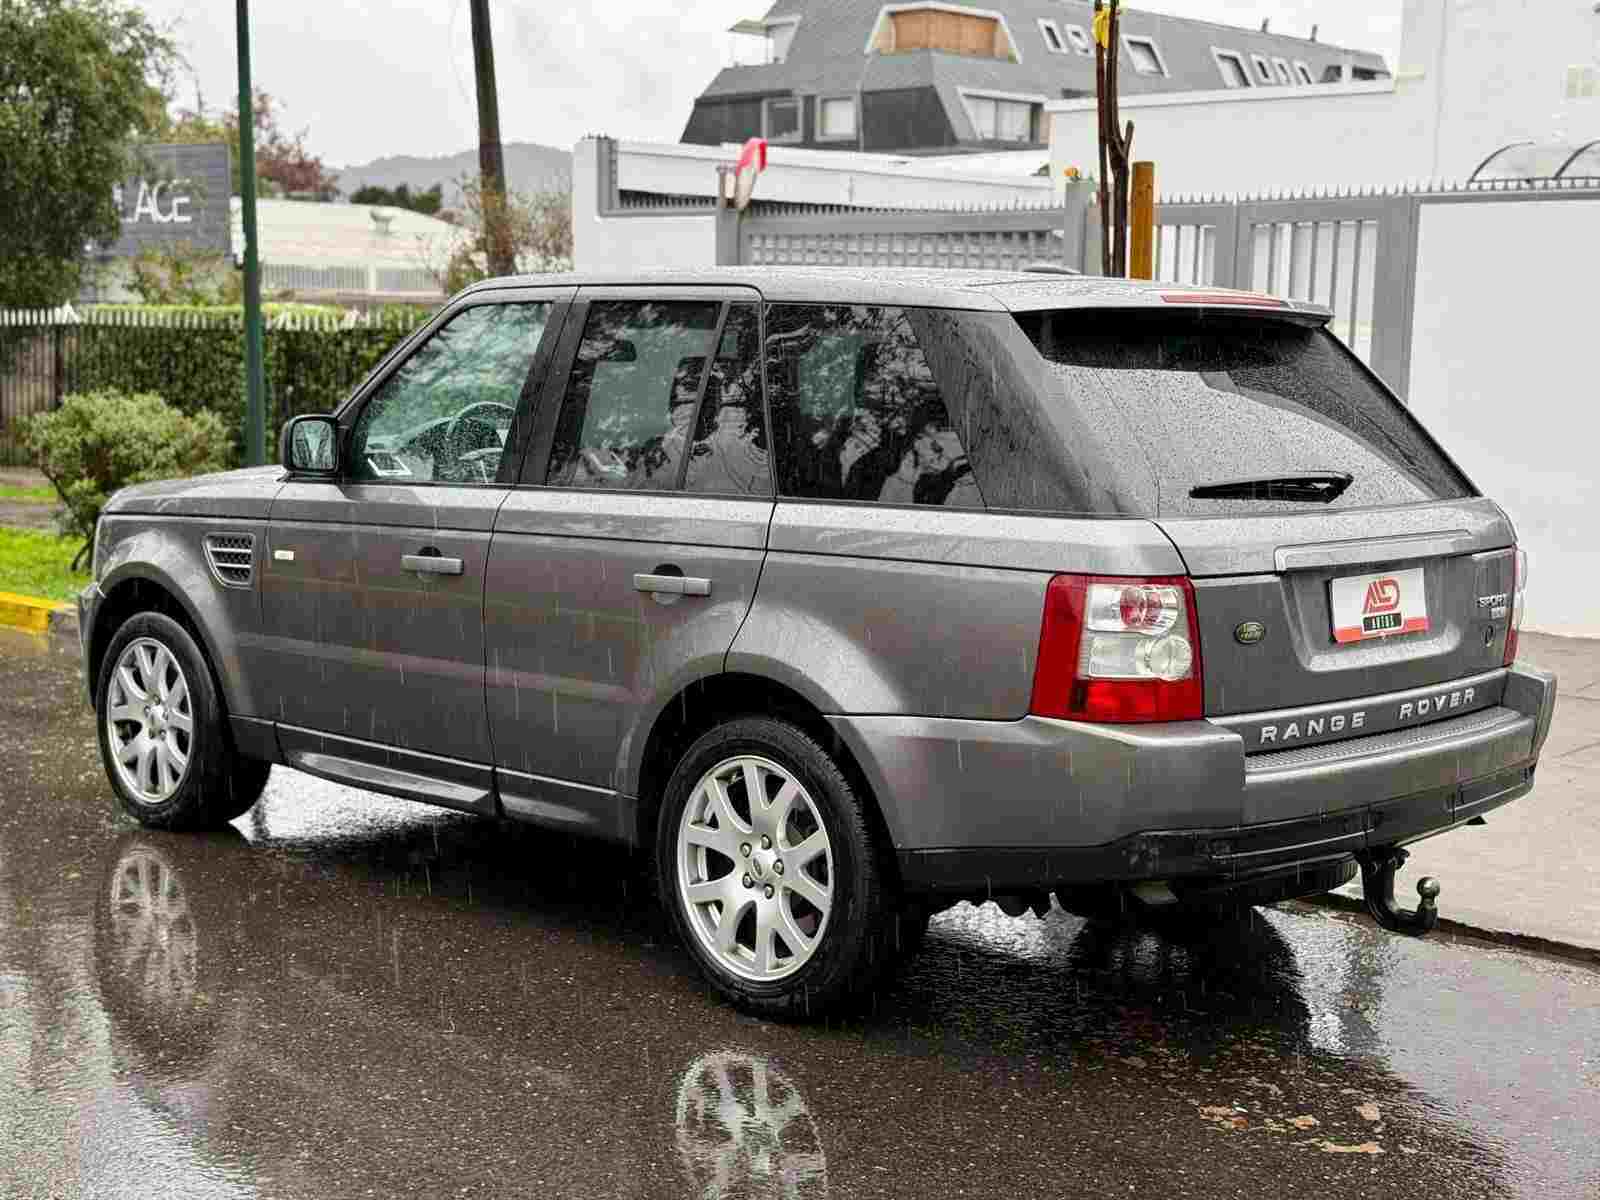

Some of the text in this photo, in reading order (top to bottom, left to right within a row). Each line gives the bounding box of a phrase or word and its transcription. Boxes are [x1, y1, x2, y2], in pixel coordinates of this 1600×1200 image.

[113, 179, 192, 223] LACE
[1260, 687, 1475, 744] RANGE ROVER
